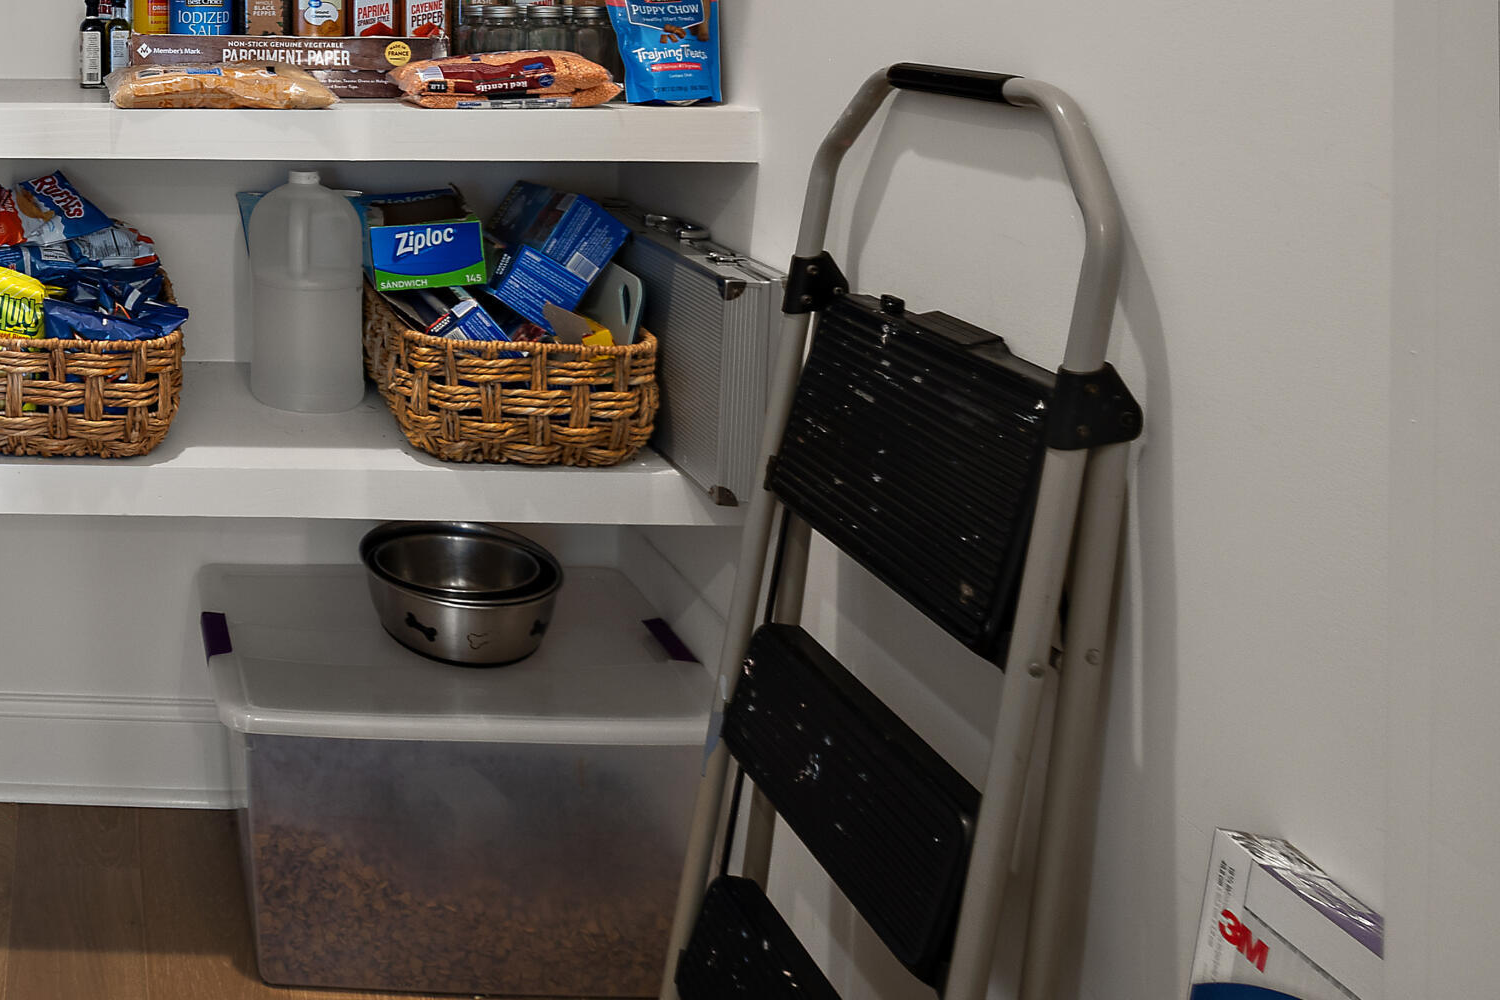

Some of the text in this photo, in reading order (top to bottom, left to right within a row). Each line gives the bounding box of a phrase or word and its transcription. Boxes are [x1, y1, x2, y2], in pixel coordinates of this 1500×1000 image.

[357, 3, 390, 19] PAPRIKA
[411, 0, 442, 15] CAYENNE
[631, 4, 699, 15] PUPPY CHOW
[178, 11, 229, 24] IODIZED
[357, 15, 390, 27] SPANISH STYLE
[411, 12, 443, 28] PEPPER
[189, 23, 222, 35] SALT
[223, 49, 350, 66] PARCHMENT PAPER
[632, 44, 708, 62] Training Treats
[475, 80, 528, 92] Red Lentils
[394, 227, 455, 257] Ziploc
[466, 274, 482, 282] 145
[1218, 908, 1270, 974] 3M
